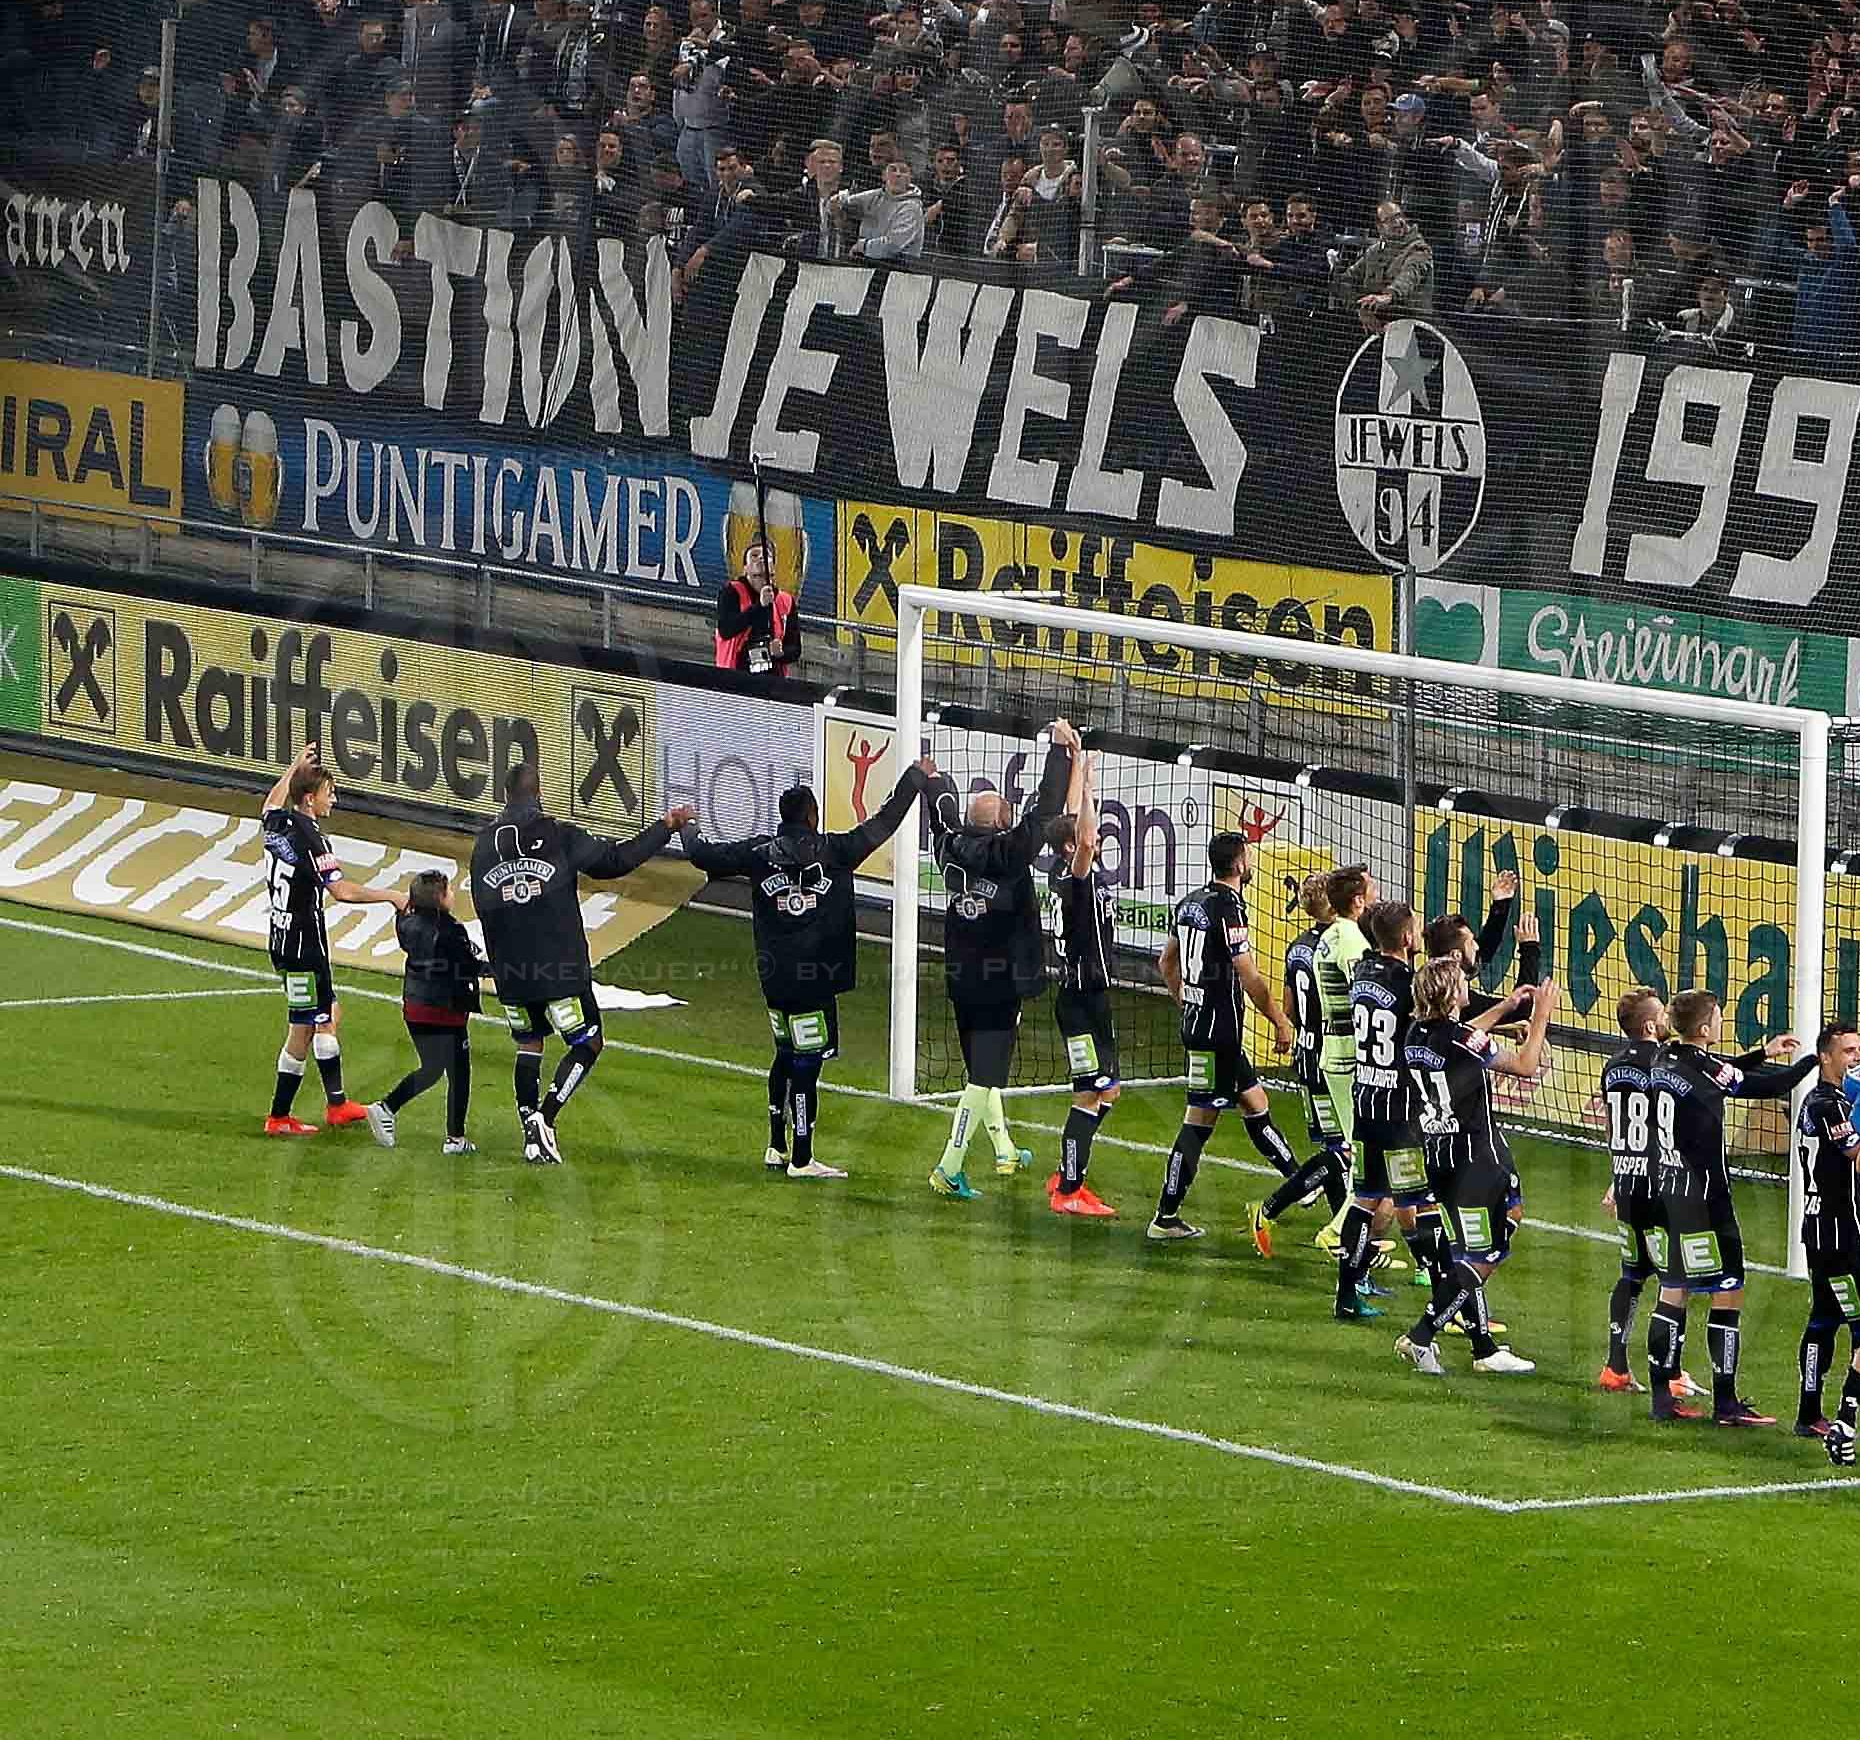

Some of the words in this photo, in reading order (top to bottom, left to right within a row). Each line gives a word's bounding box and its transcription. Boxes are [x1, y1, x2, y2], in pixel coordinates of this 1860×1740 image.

[195, 177, 670, 438] BASTION
[690, 252, 1260, 537] JEWELS
[1, 395, 171, 509] IRAL
[1344, 416, 1470, 473] JEWELS
[301, 417, 704, 588] PUNTIGAMER
[1378, 487, 1435, 548] 94
[937, 522, 1375, 695] Raiffeisen
[145, 619, 541, 803] Raiffeisen
[487, 860, 554, 888] PUNTIGAMER
[1353, 1003, 1398, 1067] 23
[1607, 1091, 1649, 1152] 18
